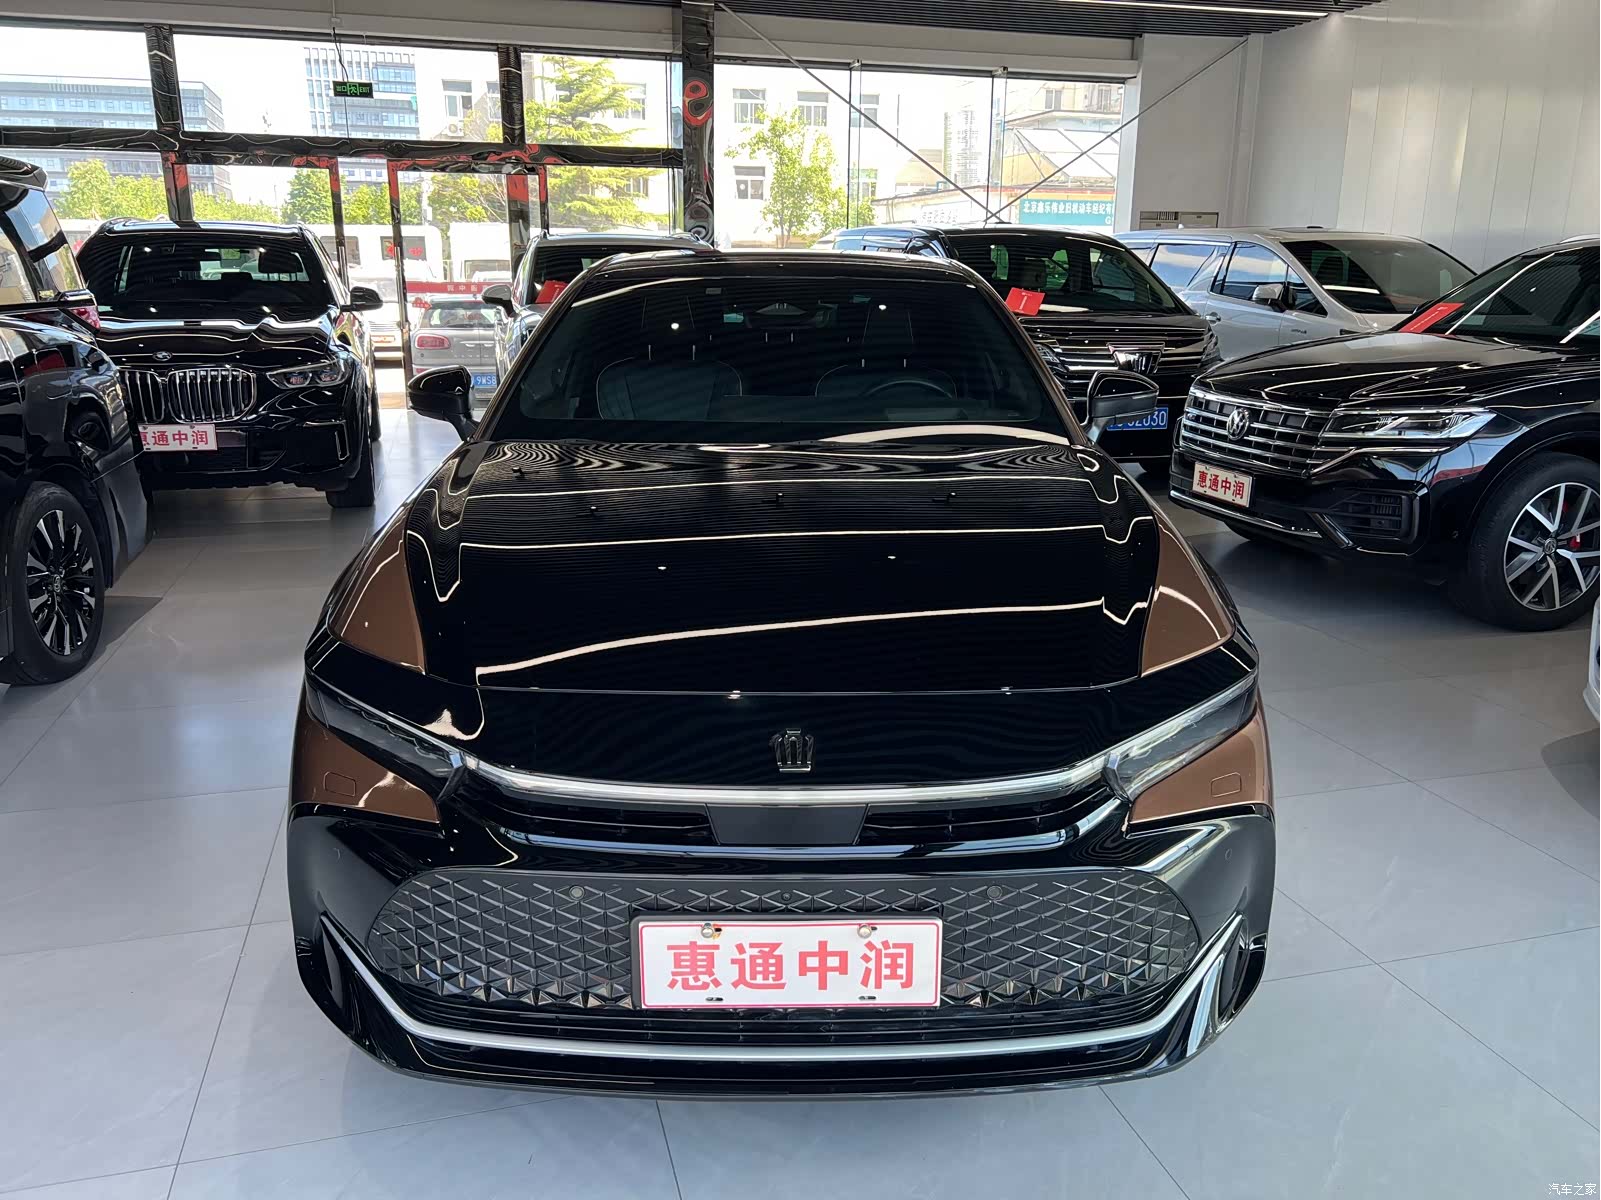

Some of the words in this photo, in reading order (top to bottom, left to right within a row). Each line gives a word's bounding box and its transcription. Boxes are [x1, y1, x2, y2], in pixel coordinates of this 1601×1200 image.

[1023, 201, 1114, 215] 北京鑫乐伟业旧机动车经纪有
[1197, 470, 1245, 499] 惠通中润
[666, 940, 914, 991] 惠通中润
